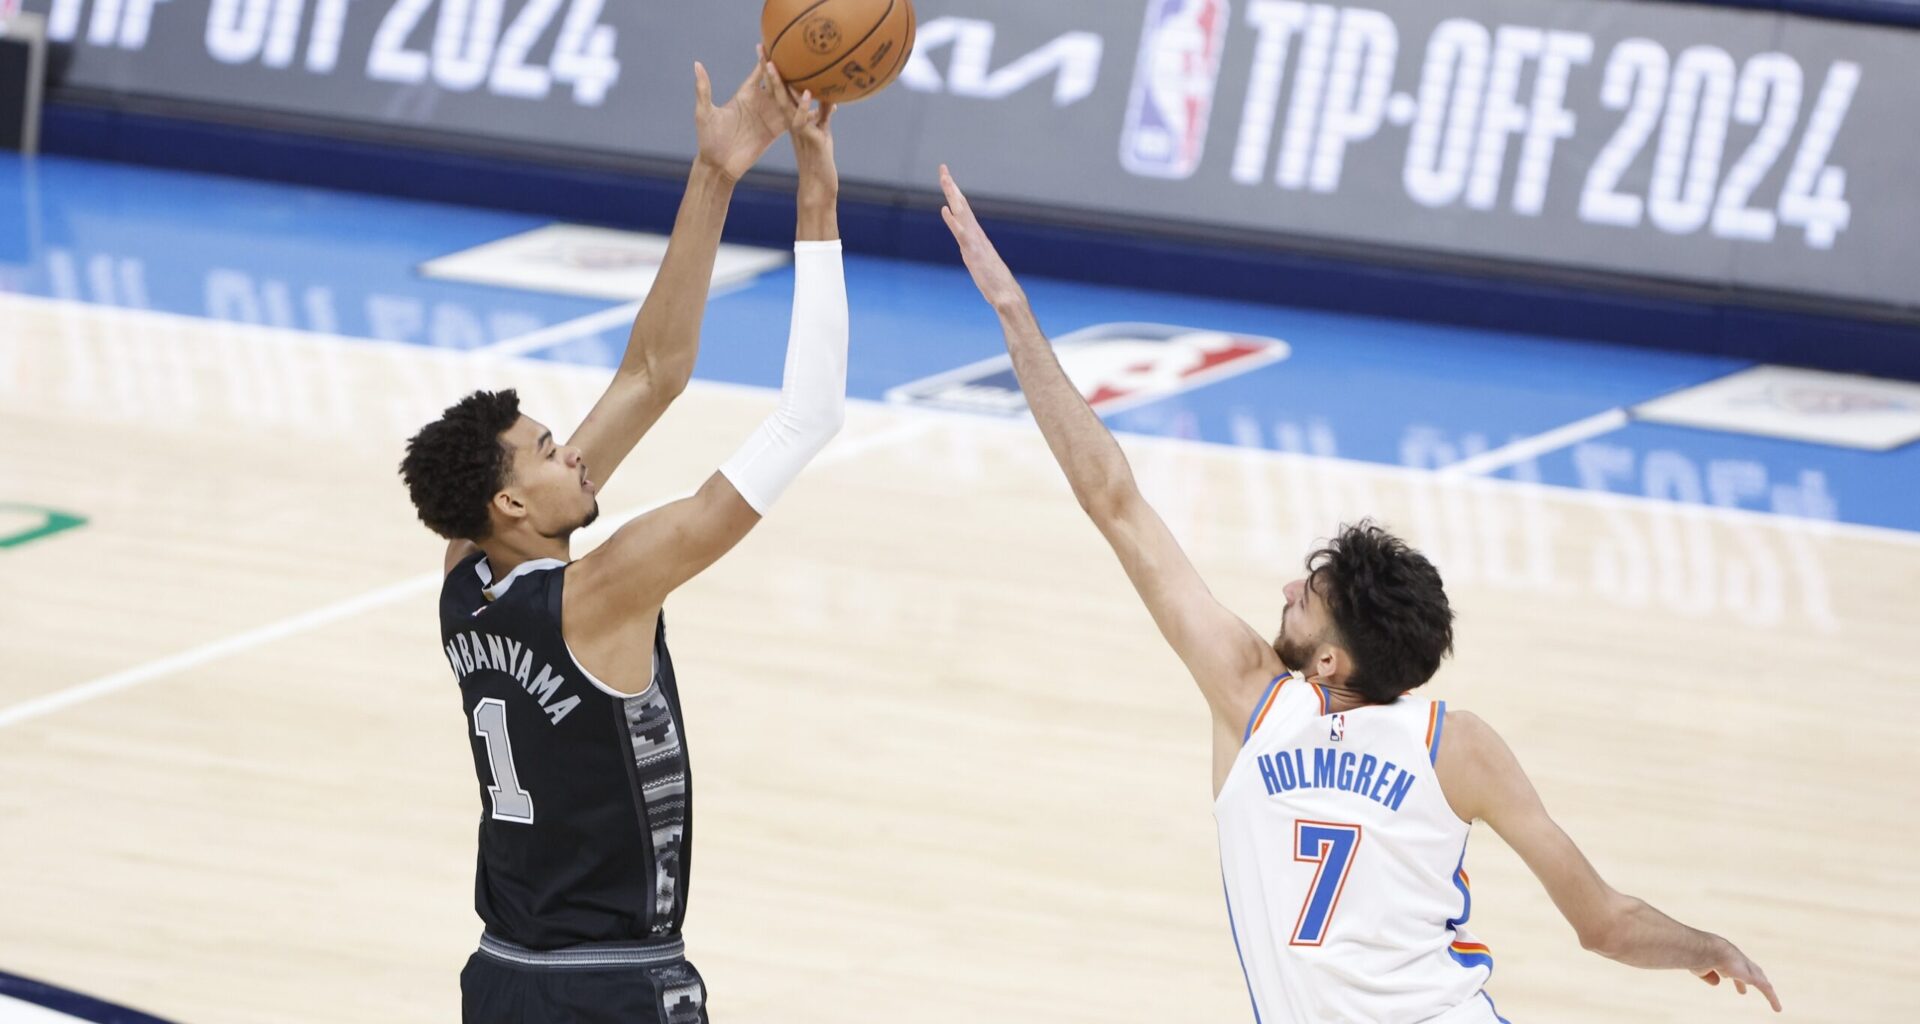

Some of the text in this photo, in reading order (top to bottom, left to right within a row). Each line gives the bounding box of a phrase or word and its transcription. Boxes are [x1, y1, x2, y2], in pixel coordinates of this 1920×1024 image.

[1578, 37, 1862, 250] 2024
[446, 630, 582, 726] MBANYAMA
[472, 697, 534, 825] 1
[1257, 748, 1416, 812] HOLMGREN
[1289, 819, 1362, 947] 7
